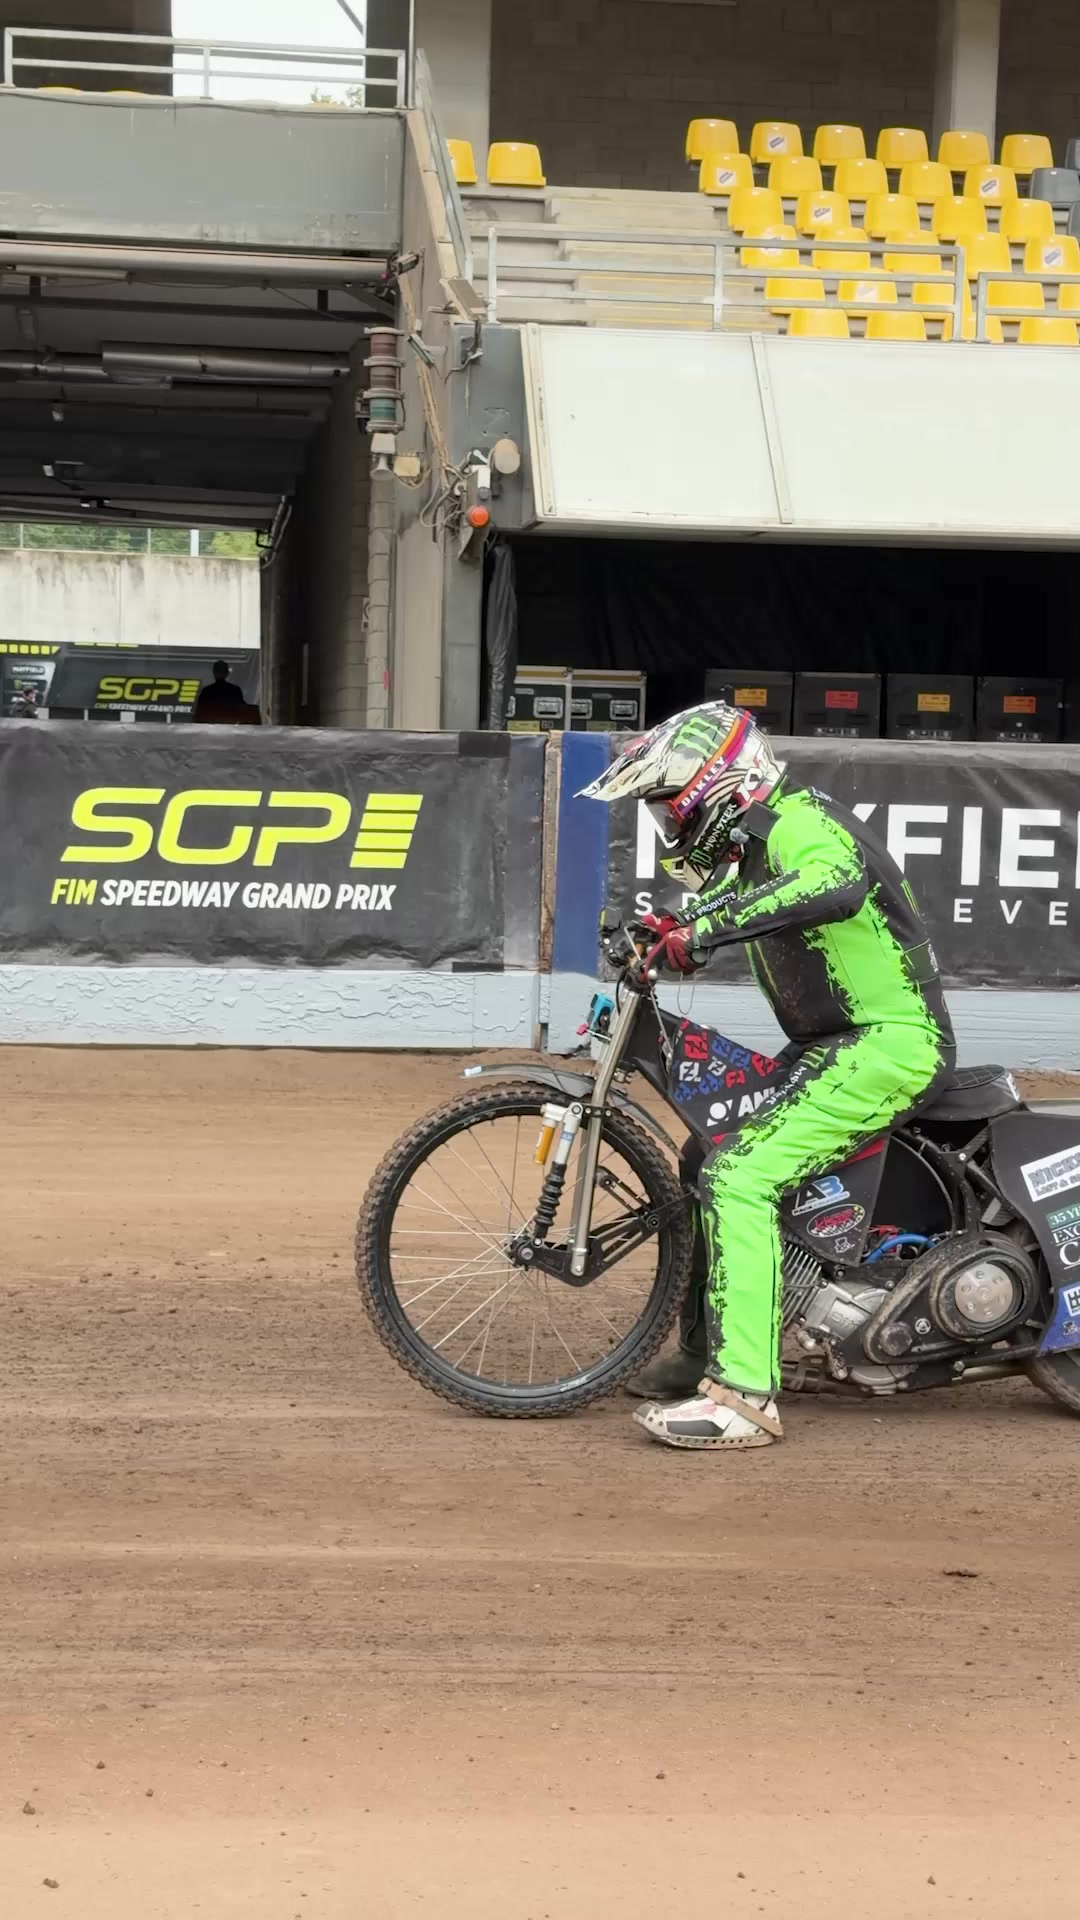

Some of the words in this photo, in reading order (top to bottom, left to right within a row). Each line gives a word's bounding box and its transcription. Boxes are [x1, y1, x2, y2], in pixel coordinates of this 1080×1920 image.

[96, 677, 180, 701] SGP
[680, 755, 726, 808] OAKLEY
[60, 787, 352, 867] SGP
[704, 803, 738, 853] MONSTER
[51, 879, 97, 906] FIM
[100, 879, 241, 909] SPEEDWAY
[242, 881, 332, 910] GRAND
[334, 884, 397, 912] PRIX
[696, 891, 737, 916] PRODUCTS
[1050, 1208, 1066, 1226] 35
